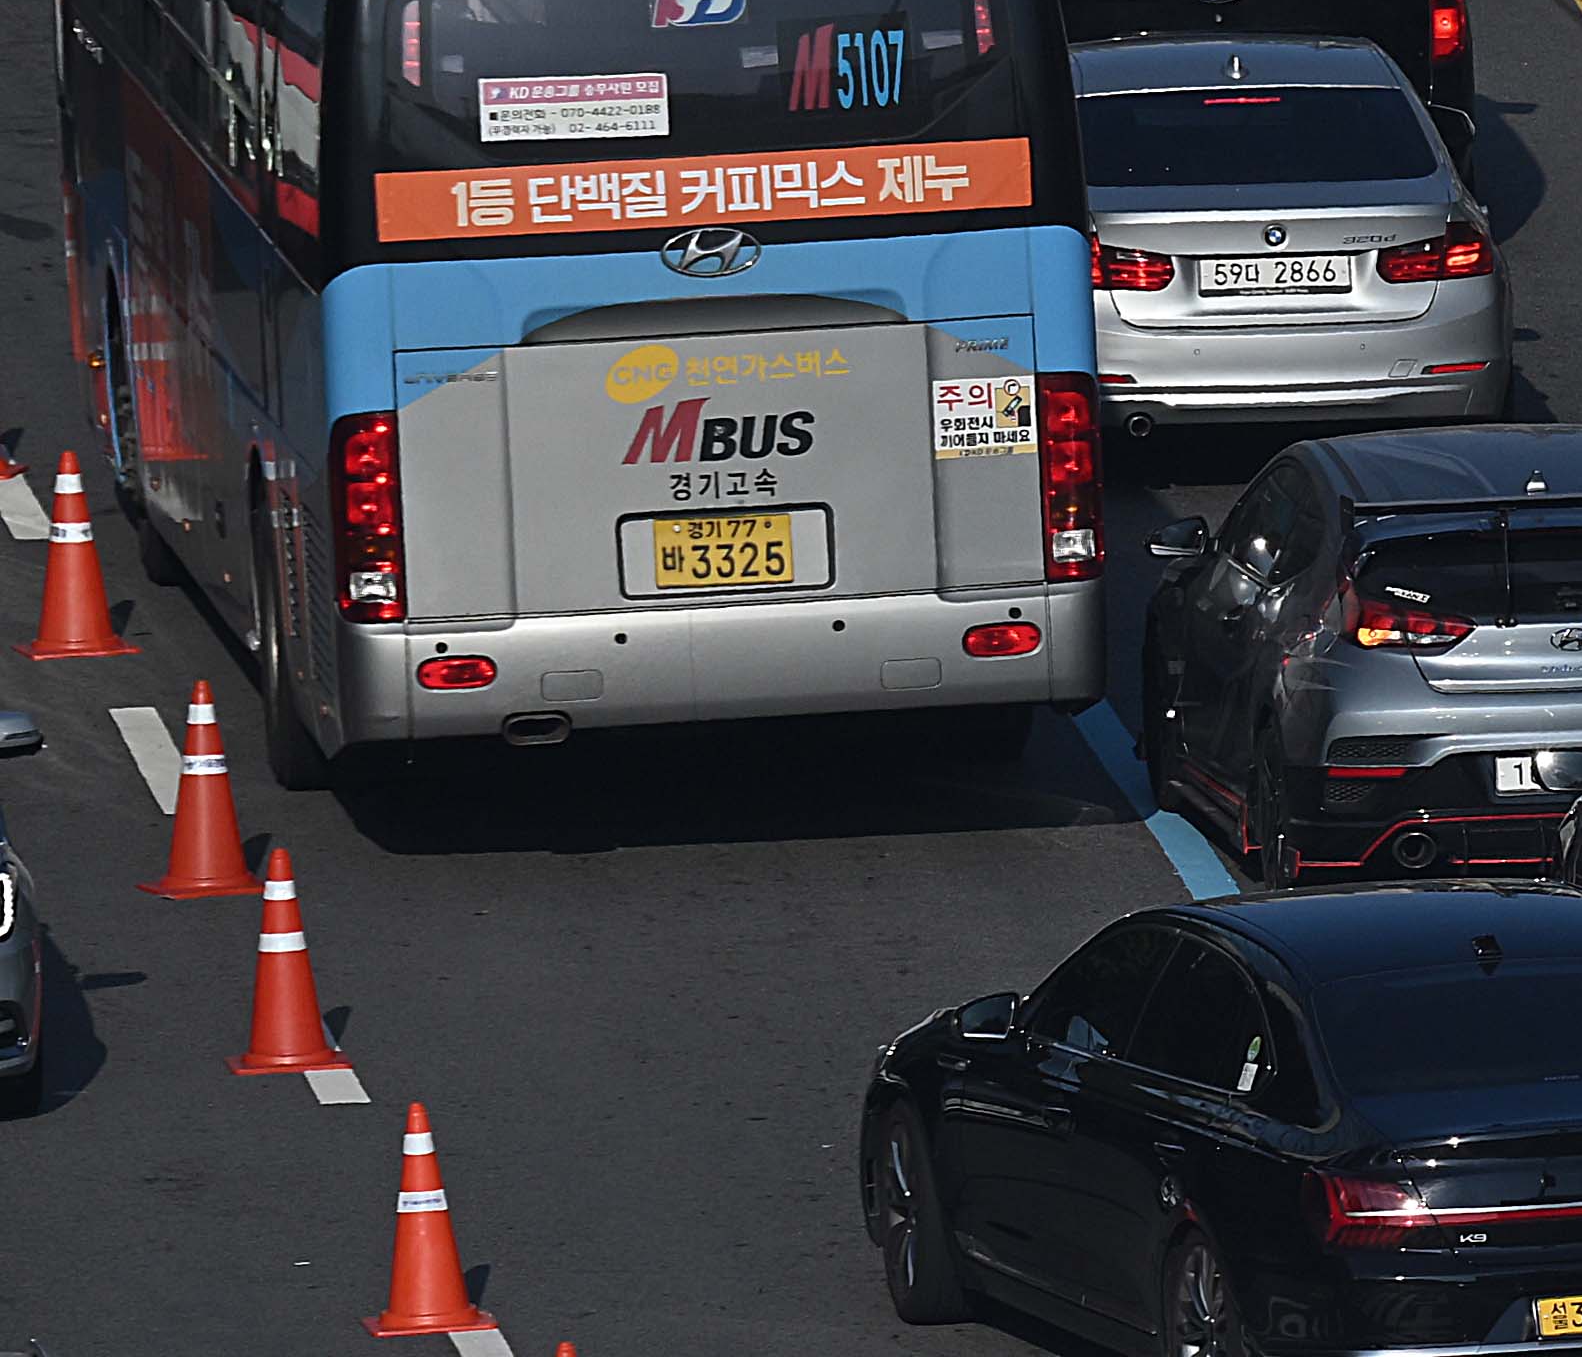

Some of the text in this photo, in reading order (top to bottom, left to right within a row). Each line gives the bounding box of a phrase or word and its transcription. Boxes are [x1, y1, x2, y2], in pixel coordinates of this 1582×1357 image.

[509, 85, 529, 99] KD
[451, 153, 970, 228] 1등 단백질 커피믹스 제누
[1342, 233, 1397, 245] 320d
[1274, 260, 1337, 284] 2866
[686, 349, 850, 387] 천연가스버스
[937, 382, 993, 411] 주의
[940, 416, 994, 432] 우회전시
[993, 429, 1031, 445] 마세요
[669, 467, 778, 501] 경기고속
[688, 519, 757, 539] 경기 77
[1460, 1233, 1487, 1244] K9
